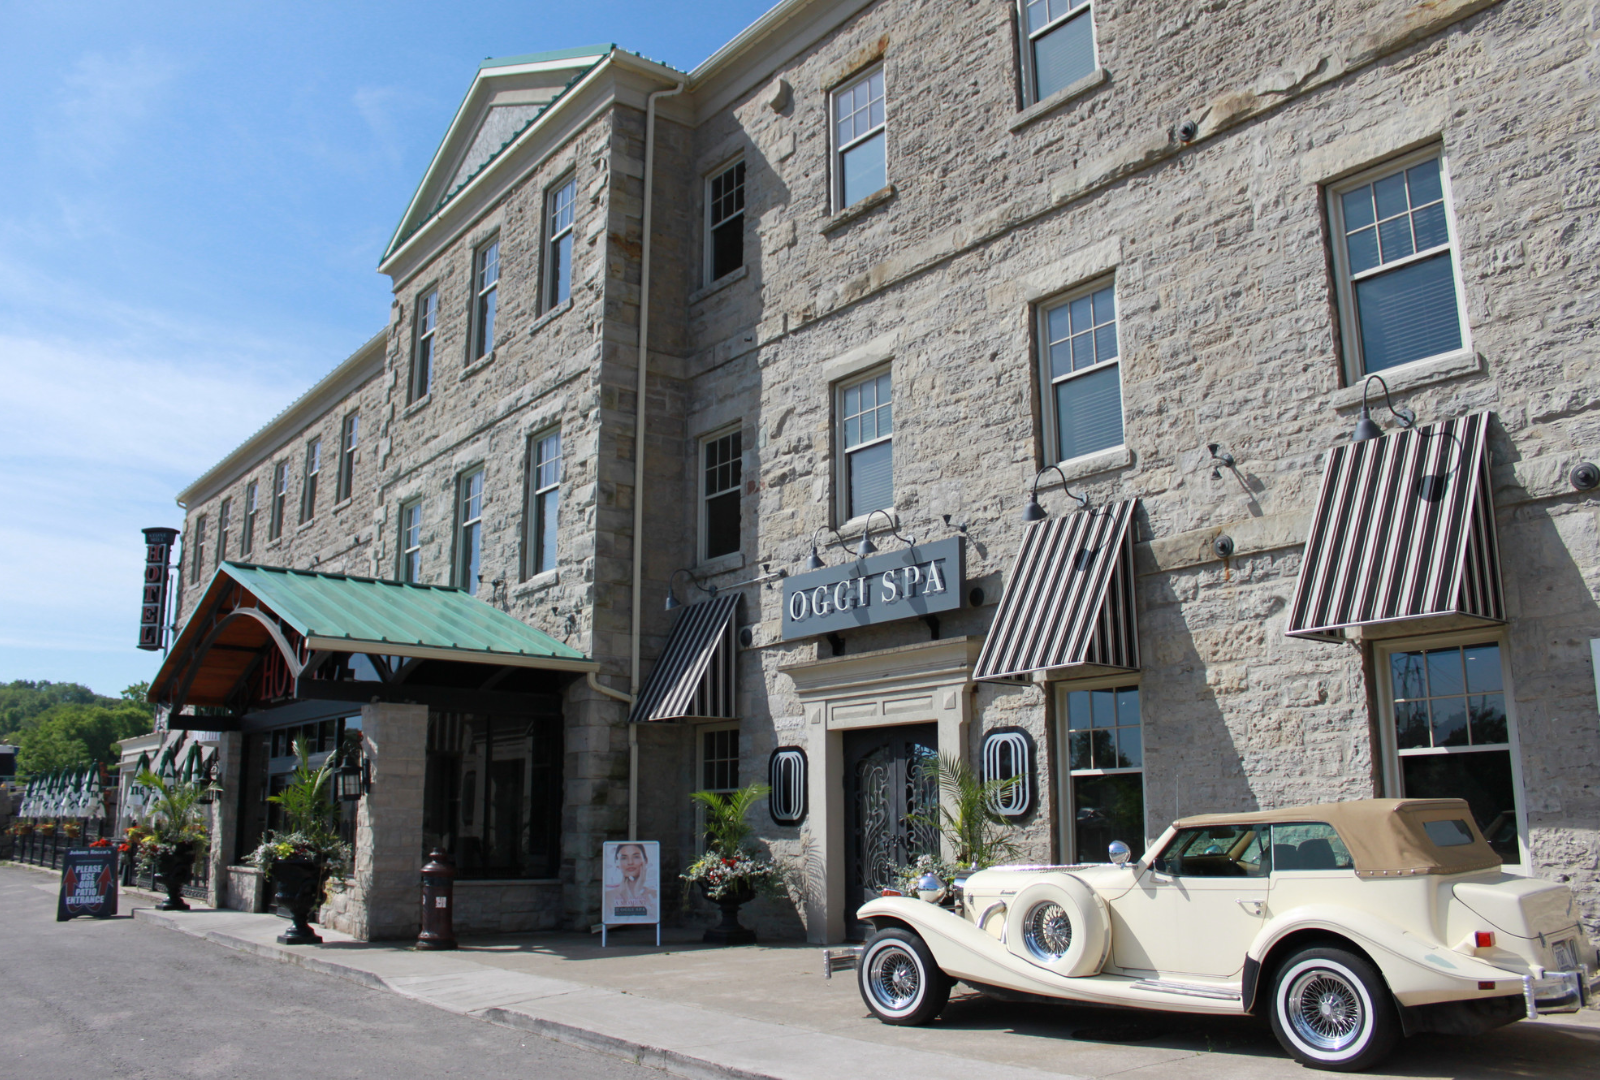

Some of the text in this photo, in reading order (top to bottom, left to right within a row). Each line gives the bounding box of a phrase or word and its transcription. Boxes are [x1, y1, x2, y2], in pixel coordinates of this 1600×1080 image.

[141, 545, 164, 643] HOTEL
[789, 560, 944, 620] OGGI SPA
[75, 865, 102, 873] PLEASE
[78, 880, 95, 888] OUR
[75, 888, 97, 896] PATIO
[66, 895, 105, 905] ENTRANCE
